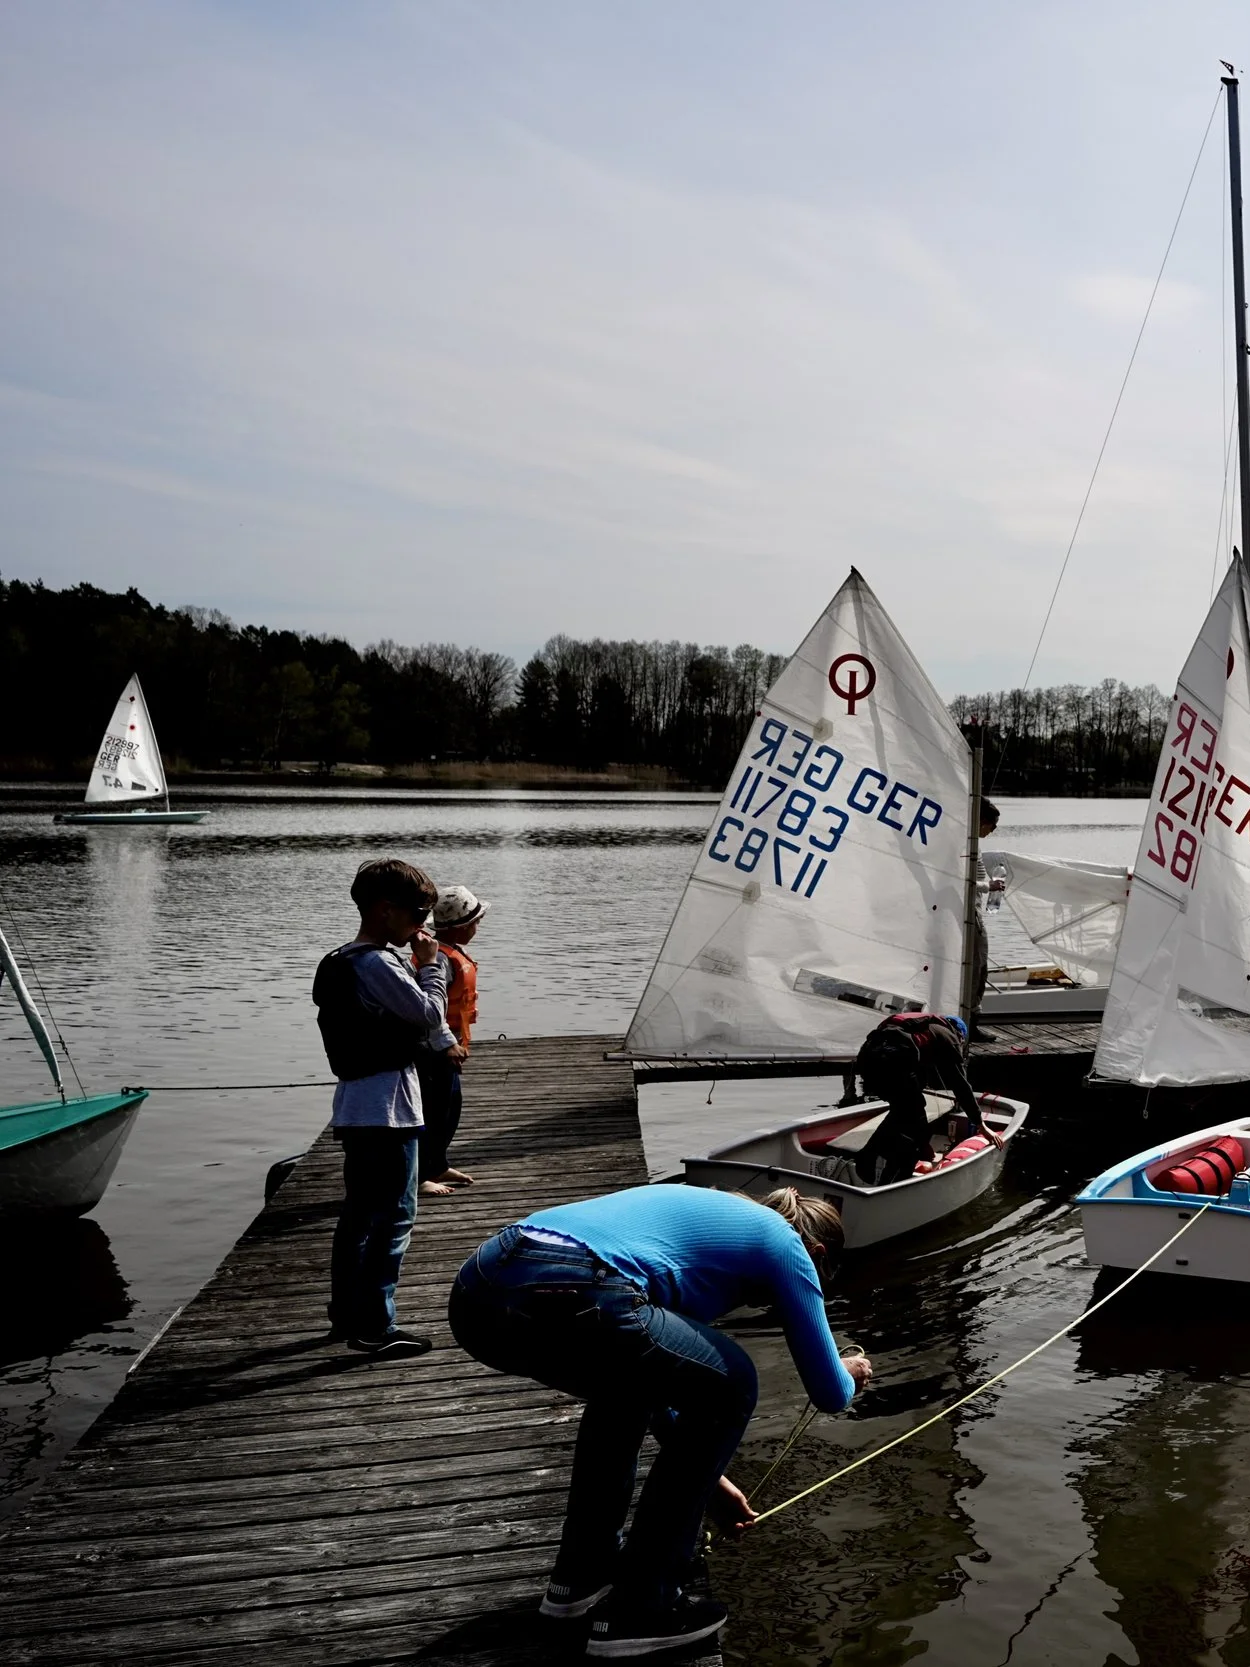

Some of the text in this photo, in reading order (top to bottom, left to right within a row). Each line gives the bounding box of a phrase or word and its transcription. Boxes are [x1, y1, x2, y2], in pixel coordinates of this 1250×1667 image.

[100, 752, 120, 763] GER
[729, 766, 849, 853] 11783
[847, 767, 943, 846] GER
